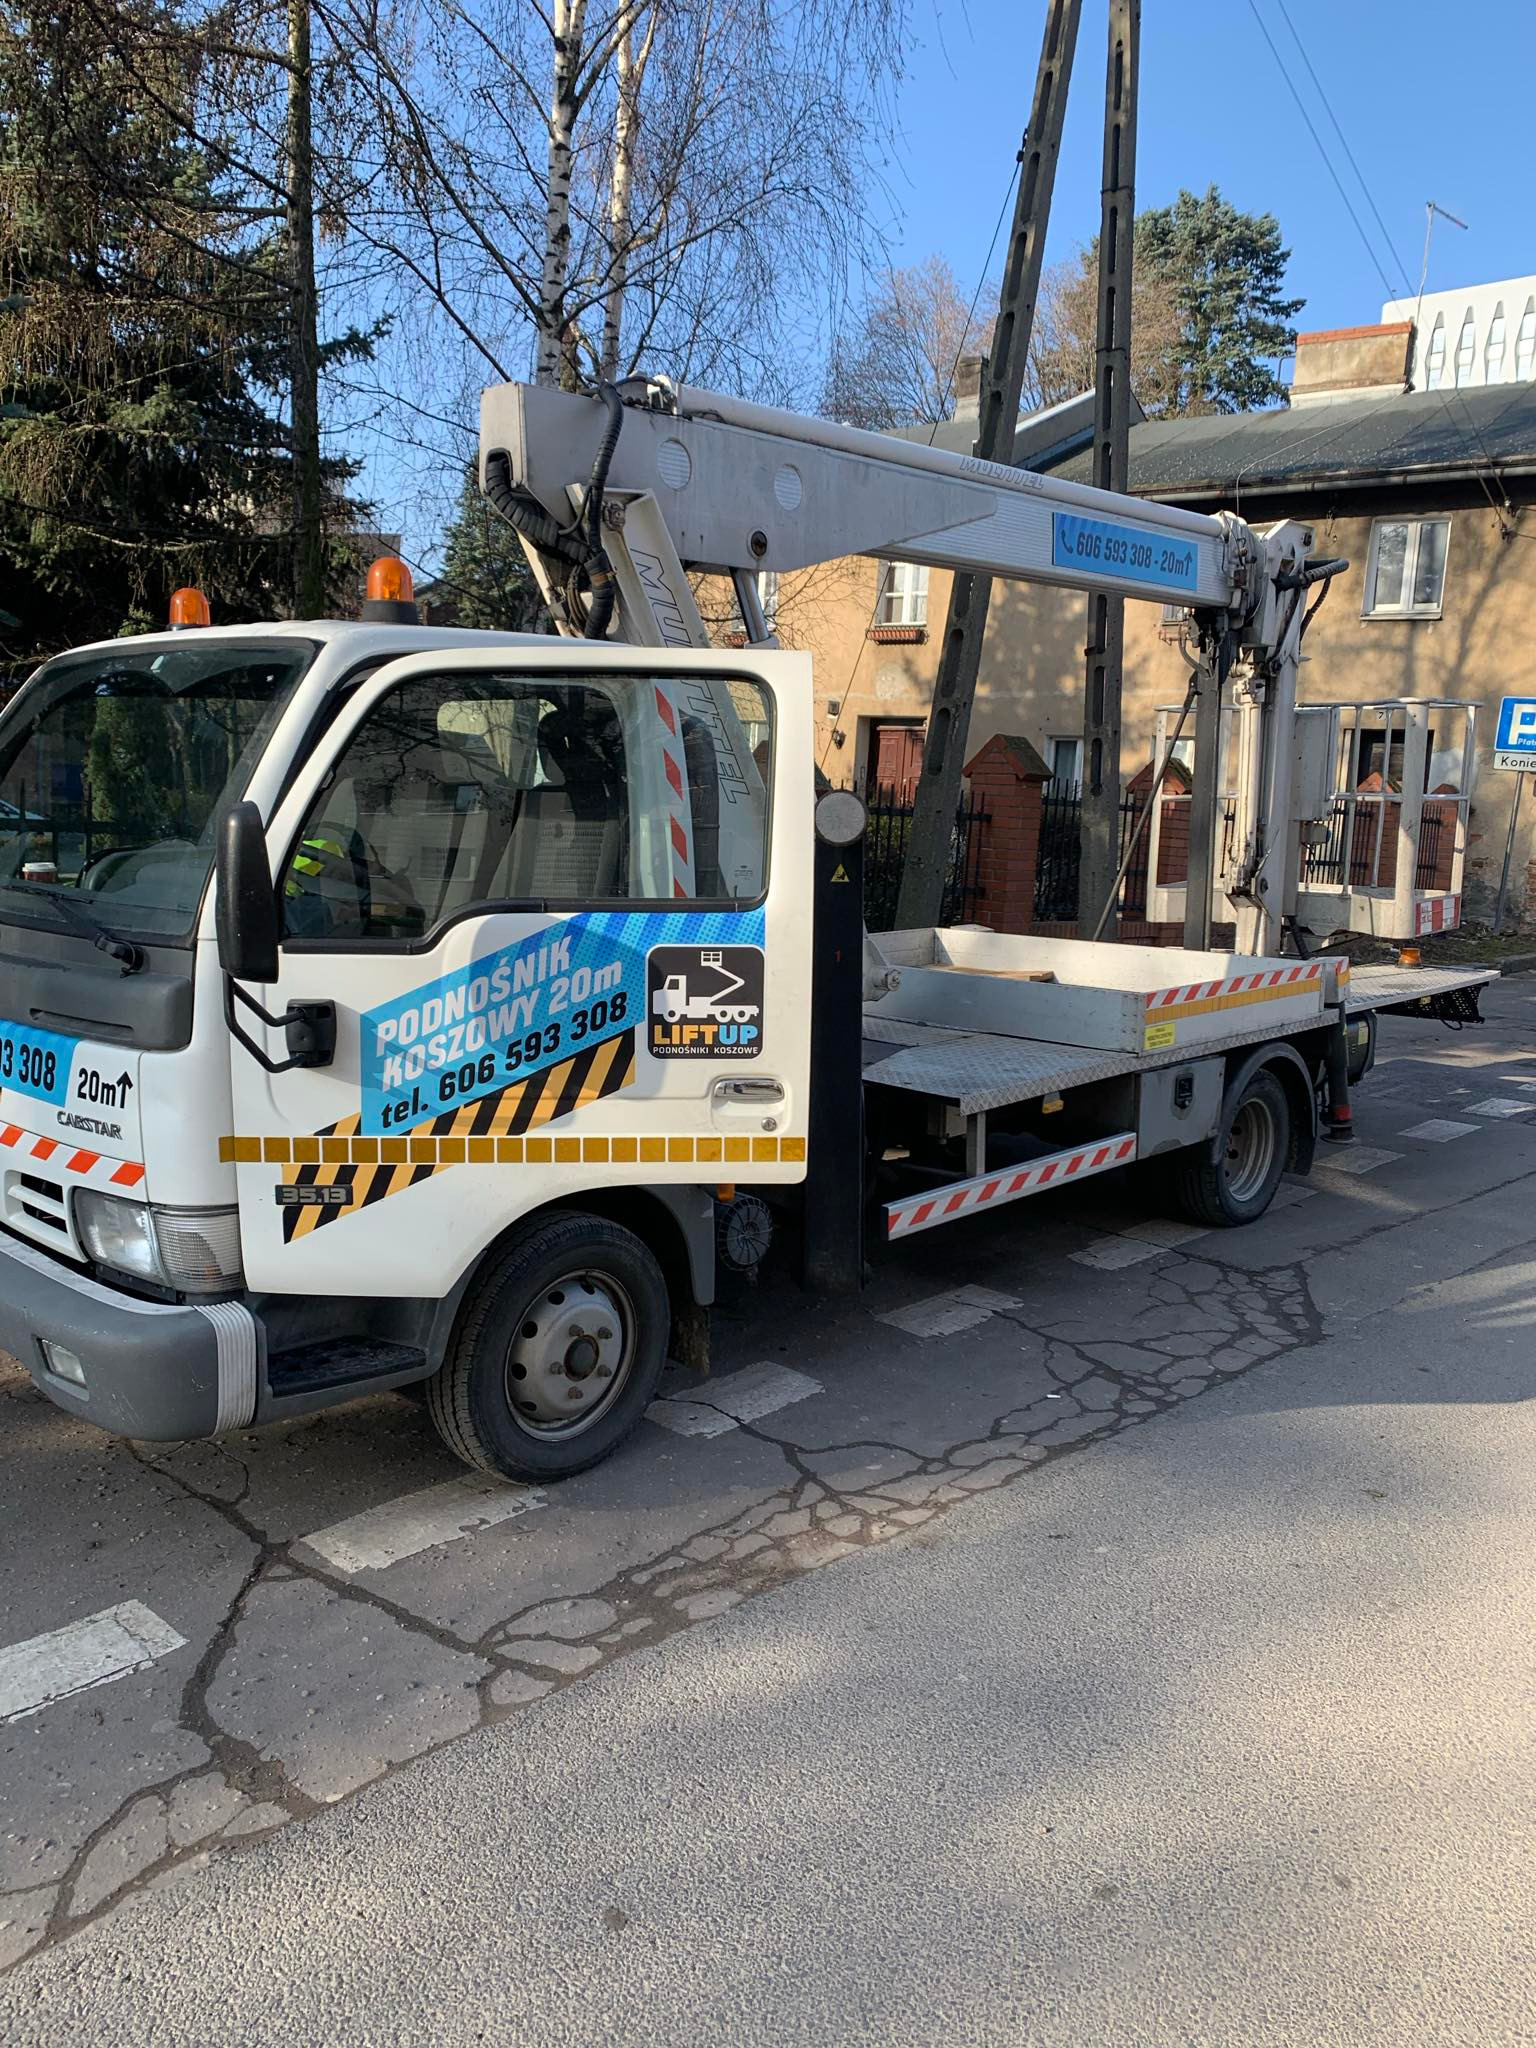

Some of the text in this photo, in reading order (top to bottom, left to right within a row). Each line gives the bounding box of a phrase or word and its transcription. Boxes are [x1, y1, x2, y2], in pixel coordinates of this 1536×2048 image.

[1076, 531, 1101, 559] 606
[1104, 538, 1128, 564] 593
[1130, 543, 1153, 569] 308
[1160, 549, 1185, 575] 20m
[376, 935, 572, 1057] PODNOŚNIK
[382, 960, 622, 1092] KOSZOWY 20m
[0, 1037, 56, 1092] 3 308
[381, 991, 628, 1129] tel. 606 593 308
[653, 1045, 759, 1055] PODNOŚNIKI KOSZOWE
[77, 1067, 117, 1107] 20m
[56, 1110, 123, 1140] CABSTAR
[282, 1187, 347, 1204] 35.13
